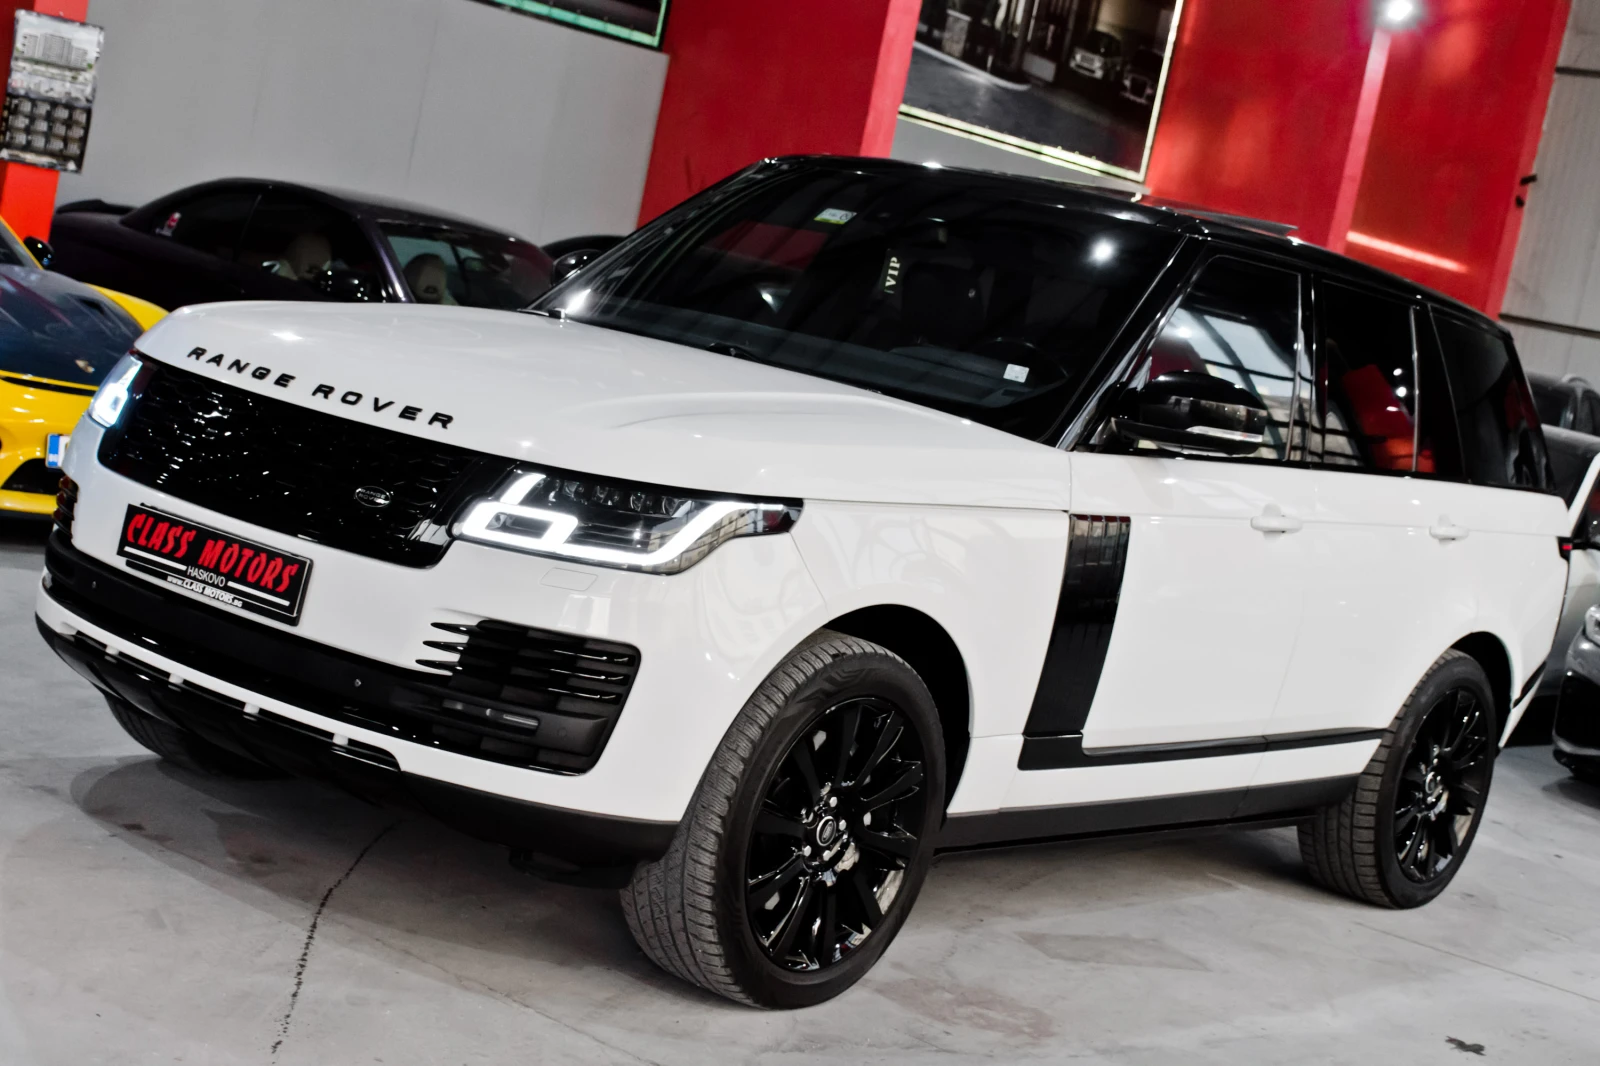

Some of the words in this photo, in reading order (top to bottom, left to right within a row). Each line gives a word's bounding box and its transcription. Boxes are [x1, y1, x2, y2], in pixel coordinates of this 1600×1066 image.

[885, 256, 901, 287] VIP
[187, 346, 296, 388] RANGE
[311, 383, 454, 429] ROVER
[359, 493, 386, 504] ROV
[360, 488, 386, 499] RANGE
[127, 513, 197, 559] CLASS
[197, 539, 300, 593] MOTORS
[186, 565, 226, 587] HASKOVO
